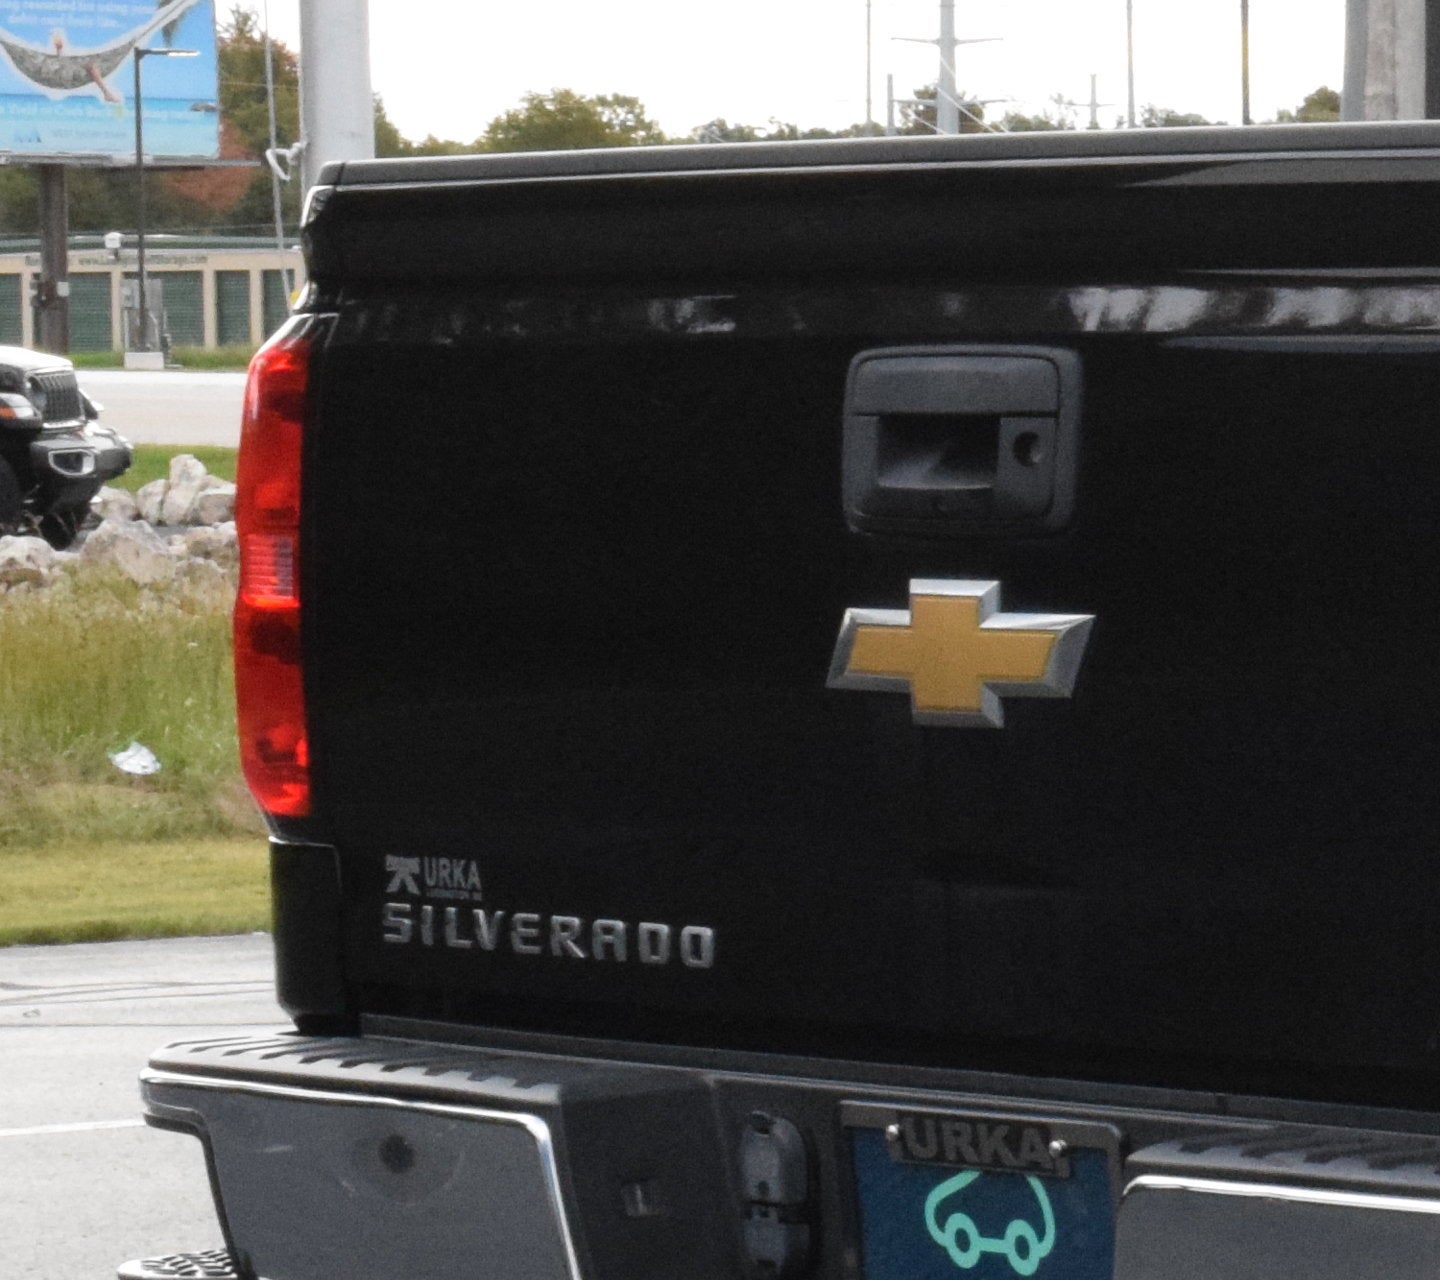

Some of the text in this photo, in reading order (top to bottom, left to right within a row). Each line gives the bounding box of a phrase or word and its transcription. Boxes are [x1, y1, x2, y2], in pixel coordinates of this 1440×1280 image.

[423, 856, 483, 890] URKA
[381, 902, 716, 968] SILVERADO
[902, 1118, 1054, 1170] URKA
